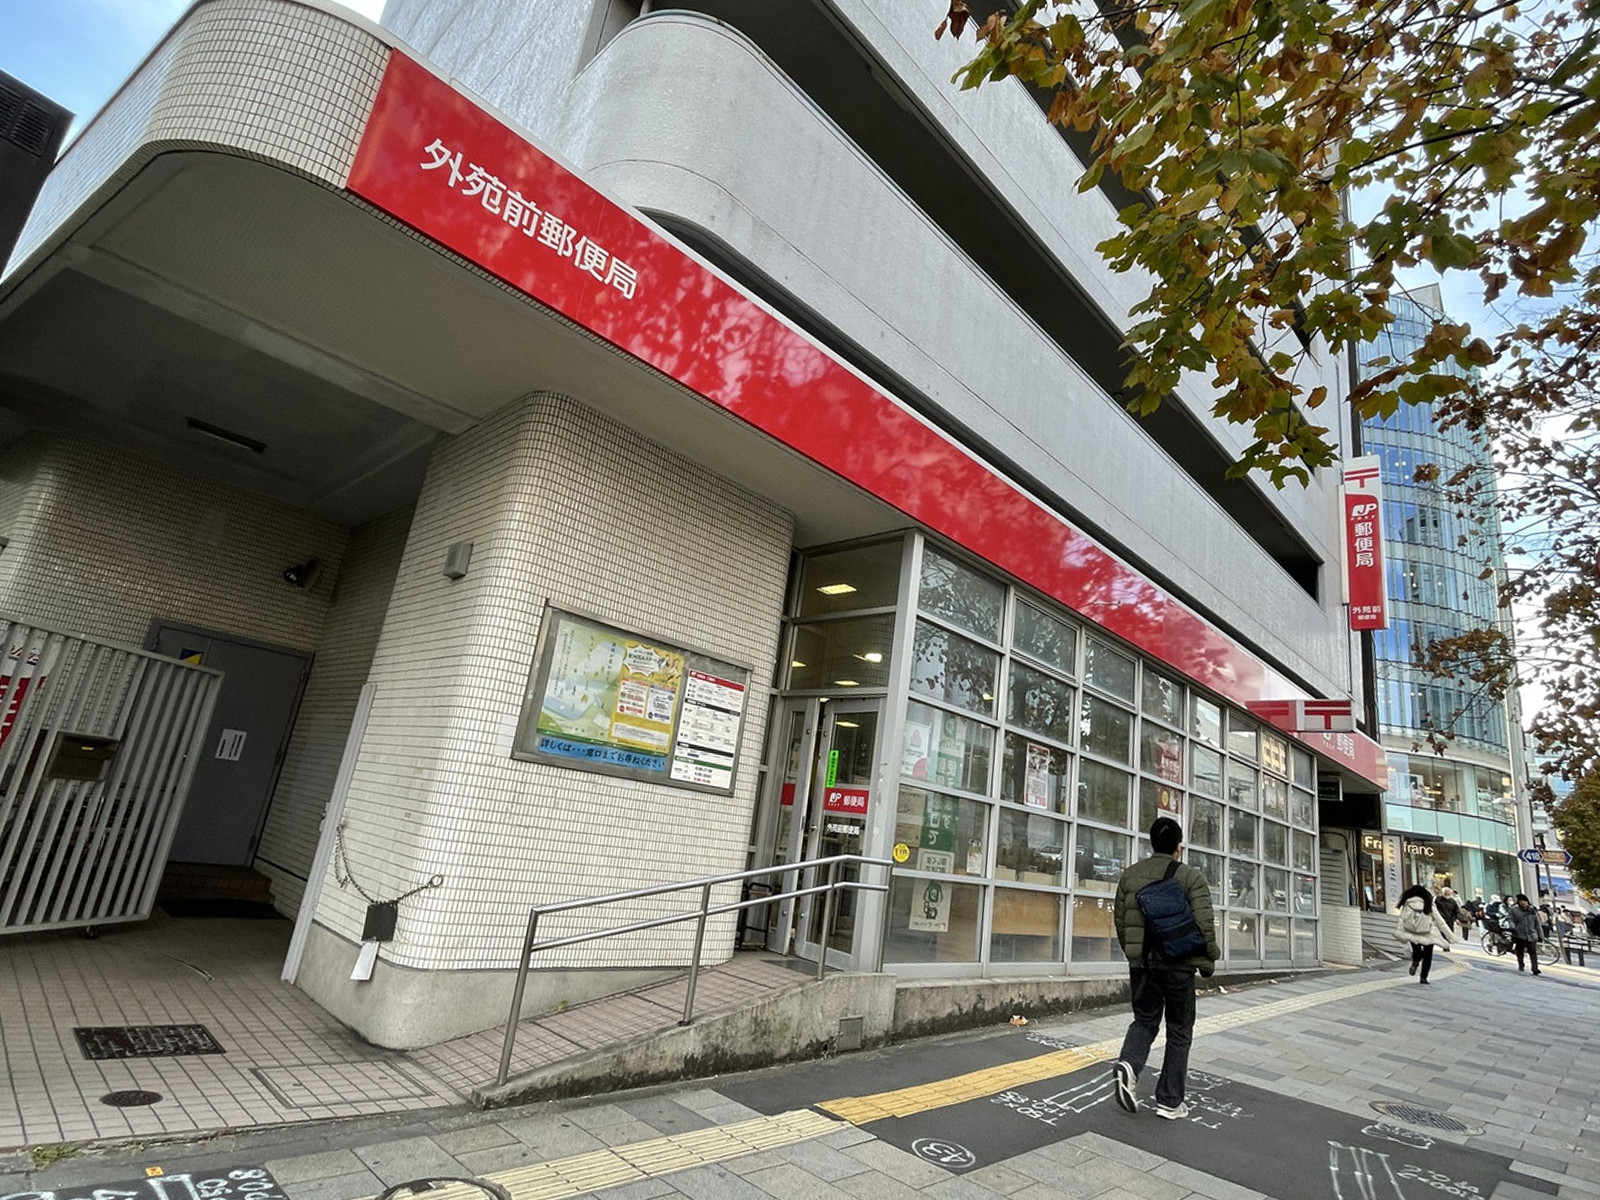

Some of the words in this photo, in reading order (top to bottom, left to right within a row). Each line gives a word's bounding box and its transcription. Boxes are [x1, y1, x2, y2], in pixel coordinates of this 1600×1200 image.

[420, 138, 638, 301] 外苑前郵便局
[1354, 522, 1374, 567] 郵便局
[1352, 606, 1382, 615] 外苑前
[842, 795, 865, 807] 郵便局
